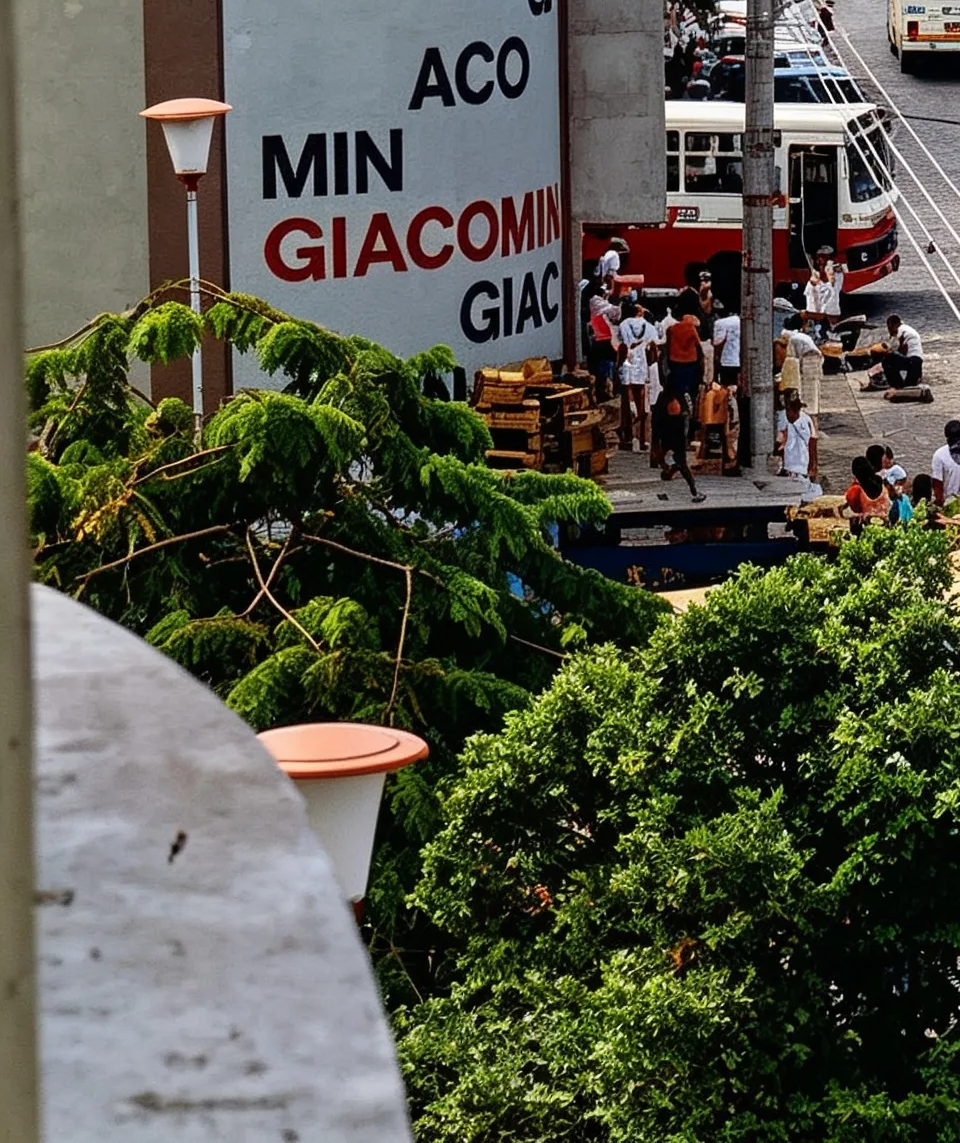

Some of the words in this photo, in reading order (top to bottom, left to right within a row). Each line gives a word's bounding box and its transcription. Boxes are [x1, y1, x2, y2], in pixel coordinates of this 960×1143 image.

[407, 35, 531, 111] ACO
[261, 127, 404, 200] MIN
[264, 182, 561, 282] GIACOMIN
[459, 260, 560, 345] GIAC
